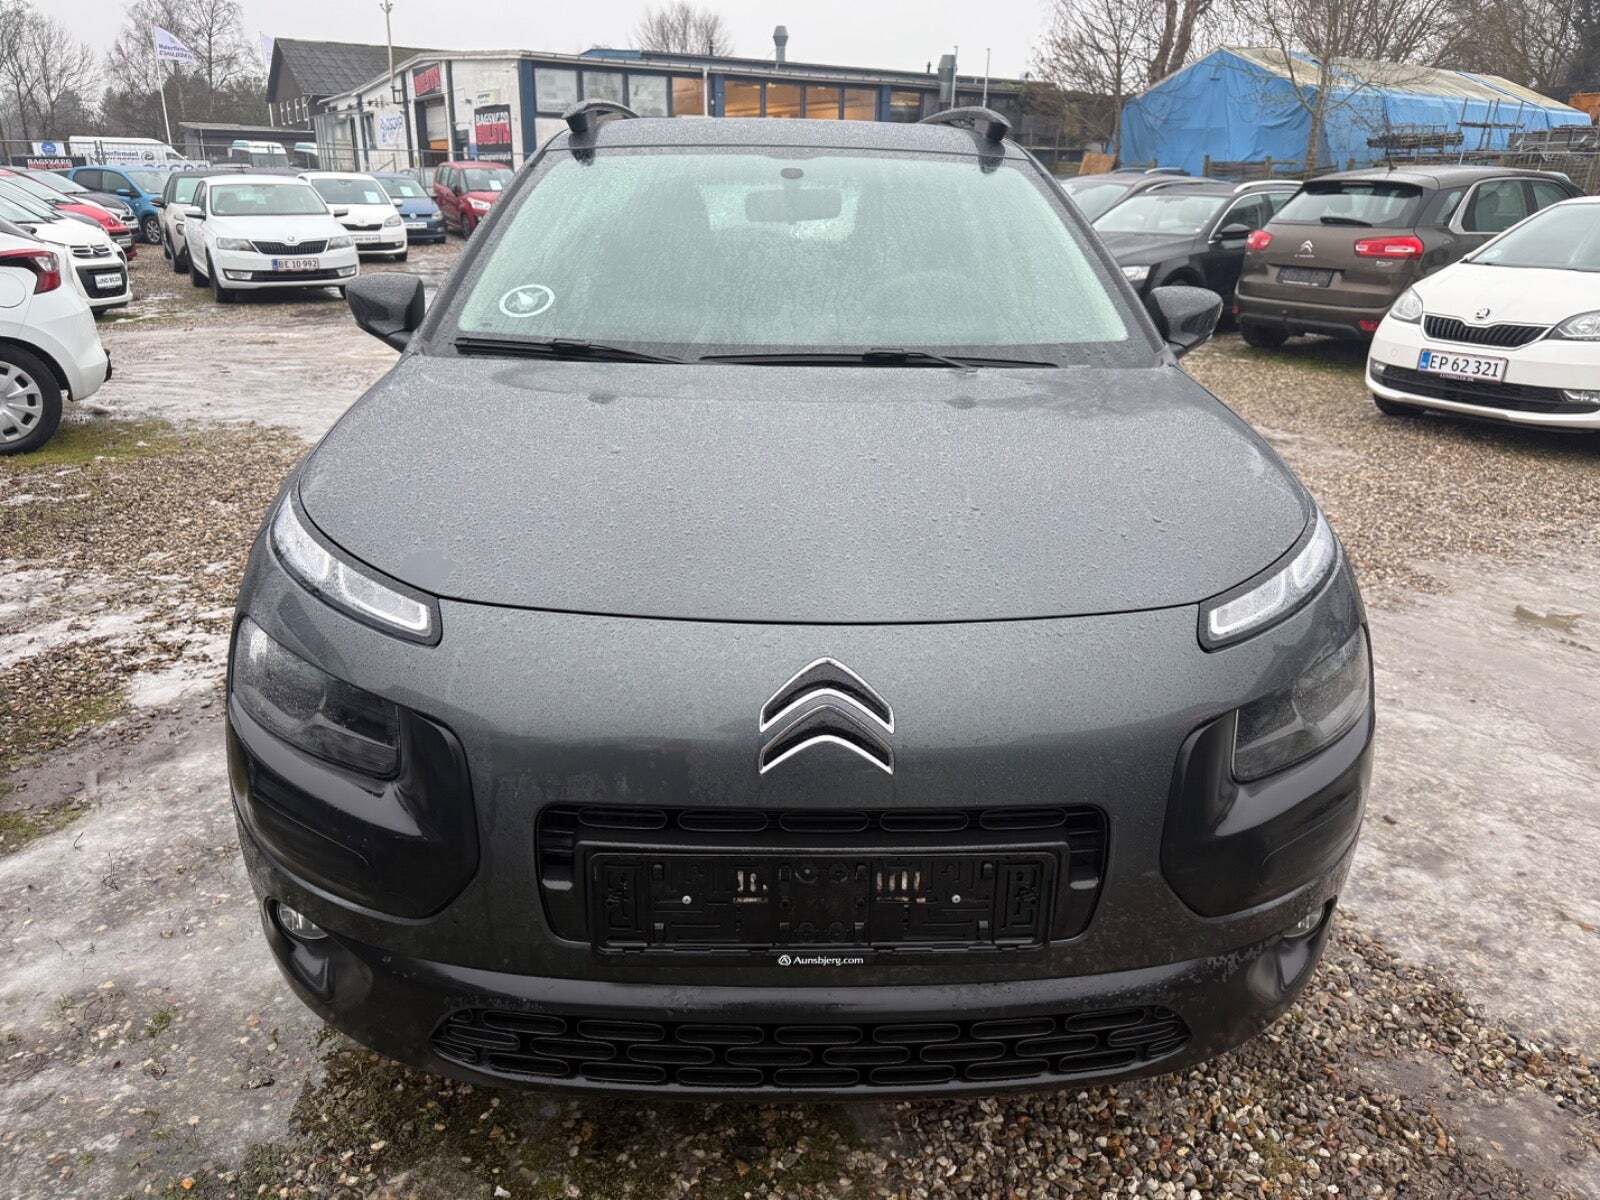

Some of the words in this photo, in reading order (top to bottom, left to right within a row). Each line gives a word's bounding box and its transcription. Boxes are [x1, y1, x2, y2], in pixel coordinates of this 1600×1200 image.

[1430, 355, 1448, 369] EP
[1451, 358, 1469, 373] 62
[1472, 361, 1499, 377] 321
[792, 956, 864, 967] Aunsbjerg.com
